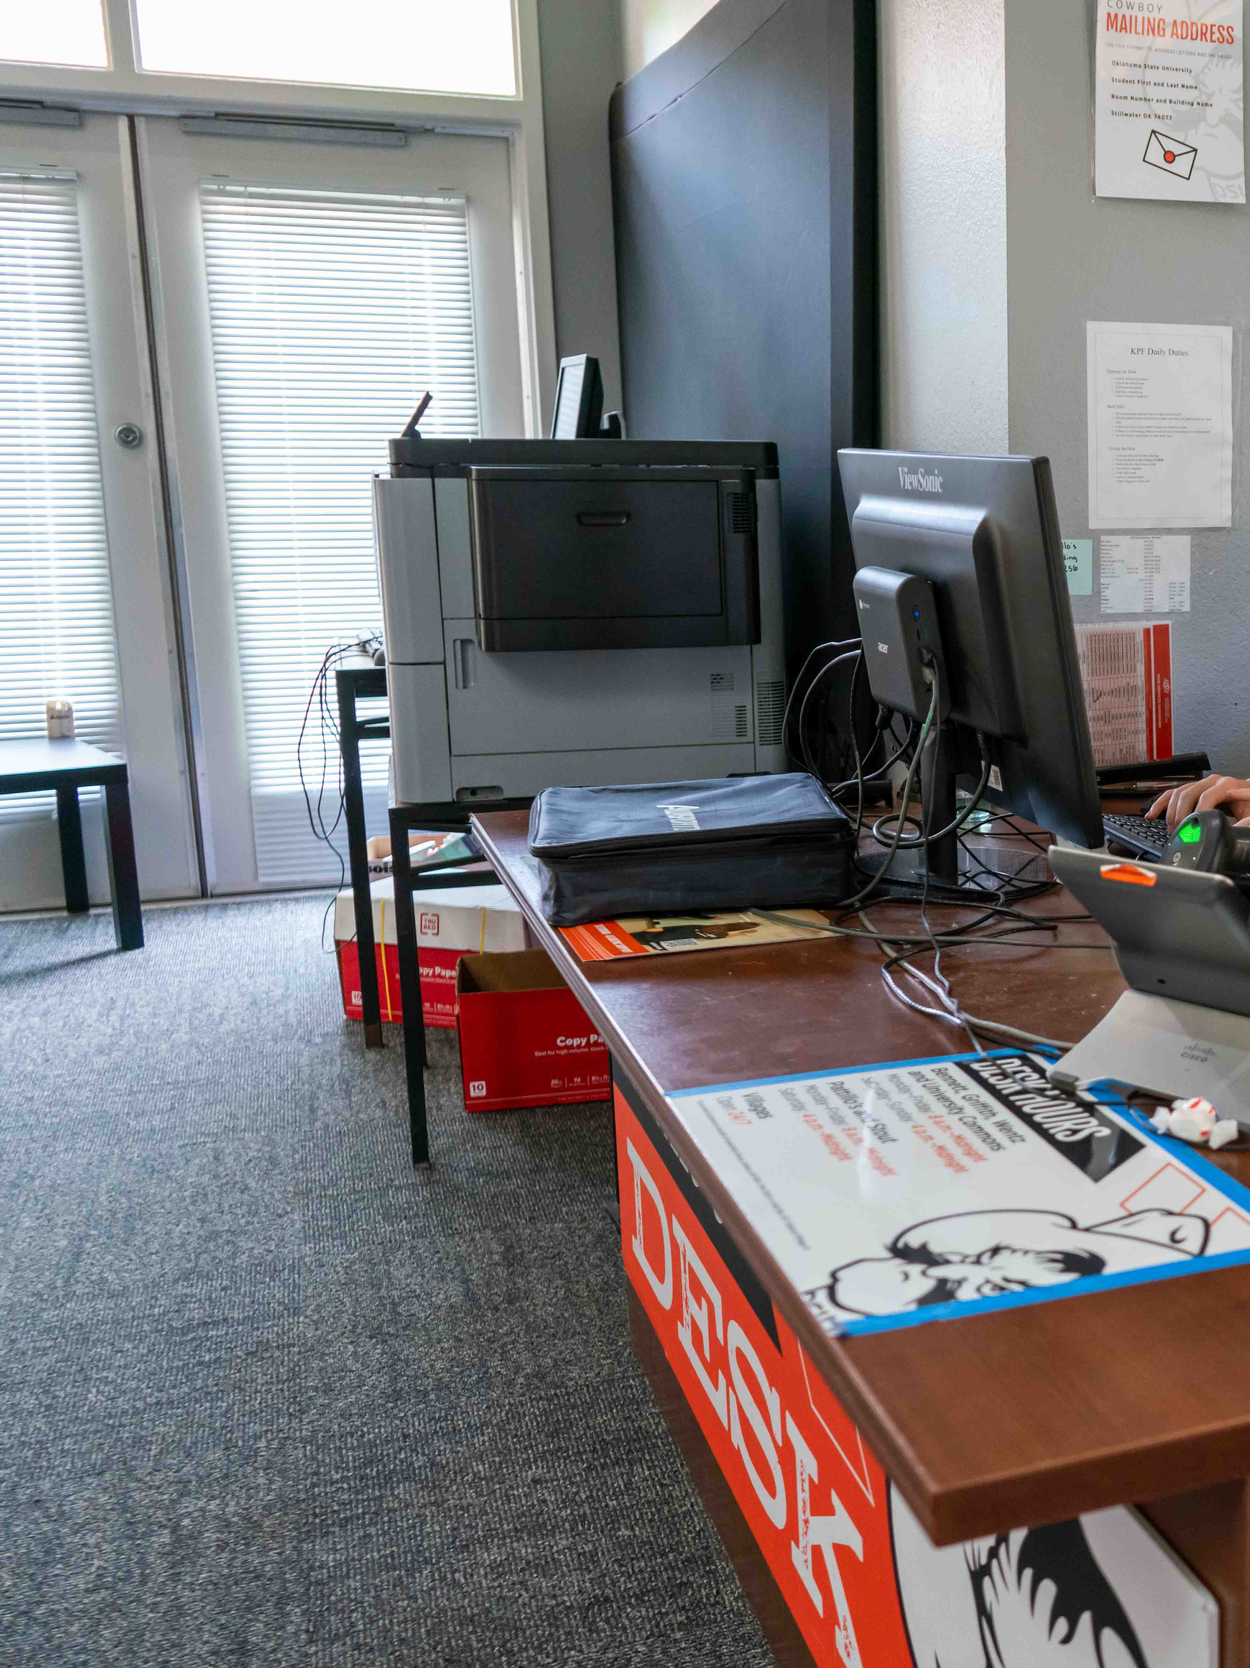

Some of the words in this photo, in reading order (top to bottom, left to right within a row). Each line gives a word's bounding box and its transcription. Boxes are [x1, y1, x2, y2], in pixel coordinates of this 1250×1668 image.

[1107, 0, 1162, 13] COWBOY
[1106, 12, 1165, 38] MAILING
[1170, 20, 1234, 45] ADDRESS
[1111, 60, 1142, 69] Oklahoma
[1161, 65, 1193, 74] University
[1111, 77, 1135, 85] Student
[1130, 95, 1154, 103] Number
[1168, 99, 1195, 107] Building
[1111, 110, 1142, 118] Stillwater
[1130, 347, 1145, 355] KPF
[1147, 347, 1166, 357] Daily
[1168, 348, 1189, 356] Duties
[898, 467, 943, 493] ViewSonic
[878, 642, 888, 654] acer
[418, 966, 433, 977] opy
[434, 966, 457, 977] Pape
[556, 1035, 587, 1048] Copy
[589, 1033, 604, 1044] Pa
[970, 1057, 1053, 1096] DESK
[471, 1083, 484, 1092] 10
[716, 1095, 738, 1111] Open
[741, 1091, 774, 1119] Villages
[931, 1067, 970, 1094] Bennett,
[962, 1093, 999, 1121] Griffith,
[992, 1119, 1026, 1144] Wentz
[908, 1071, 932, 1088] and
[922, 1079, 966, 1115] University
[958, 1115, 1006, 1152] Commons
[1008, 1089, 1111, 1142] HOURS
[868, 1119, 899, 1144] Stout
[626, 1136, 865, 1668] DESK
